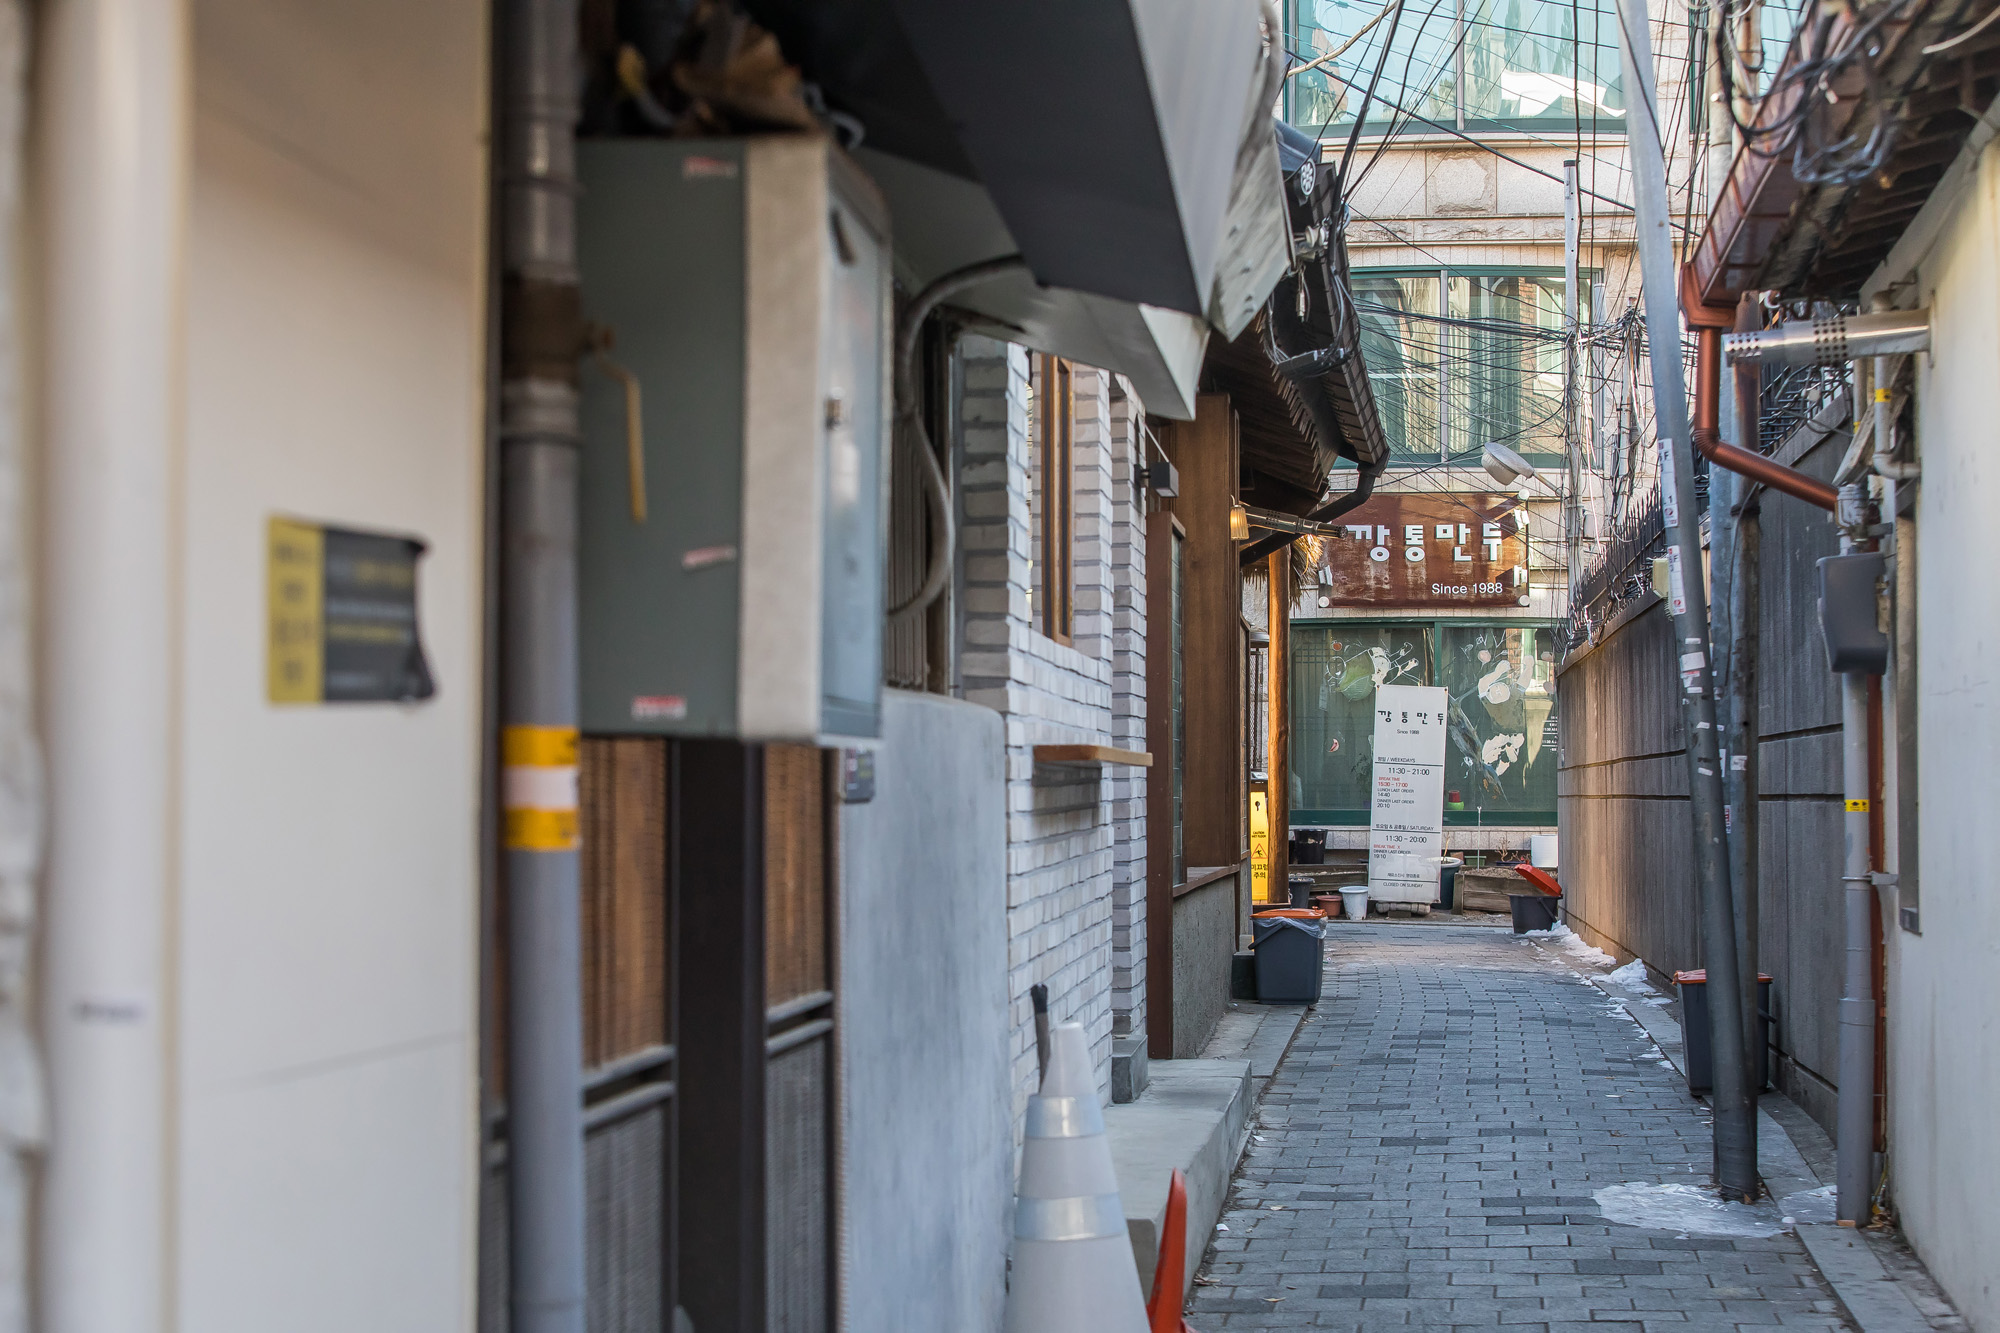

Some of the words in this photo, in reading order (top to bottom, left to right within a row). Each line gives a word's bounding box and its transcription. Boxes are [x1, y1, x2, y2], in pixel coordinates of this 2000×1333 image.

[1345, 522, 1502, 562] 깡통만두
[1432, 583, 1468, 594] Since
[1472, 583, 1503, 594] 1988
[1378, 710, 1444, 726] 깡통만두
